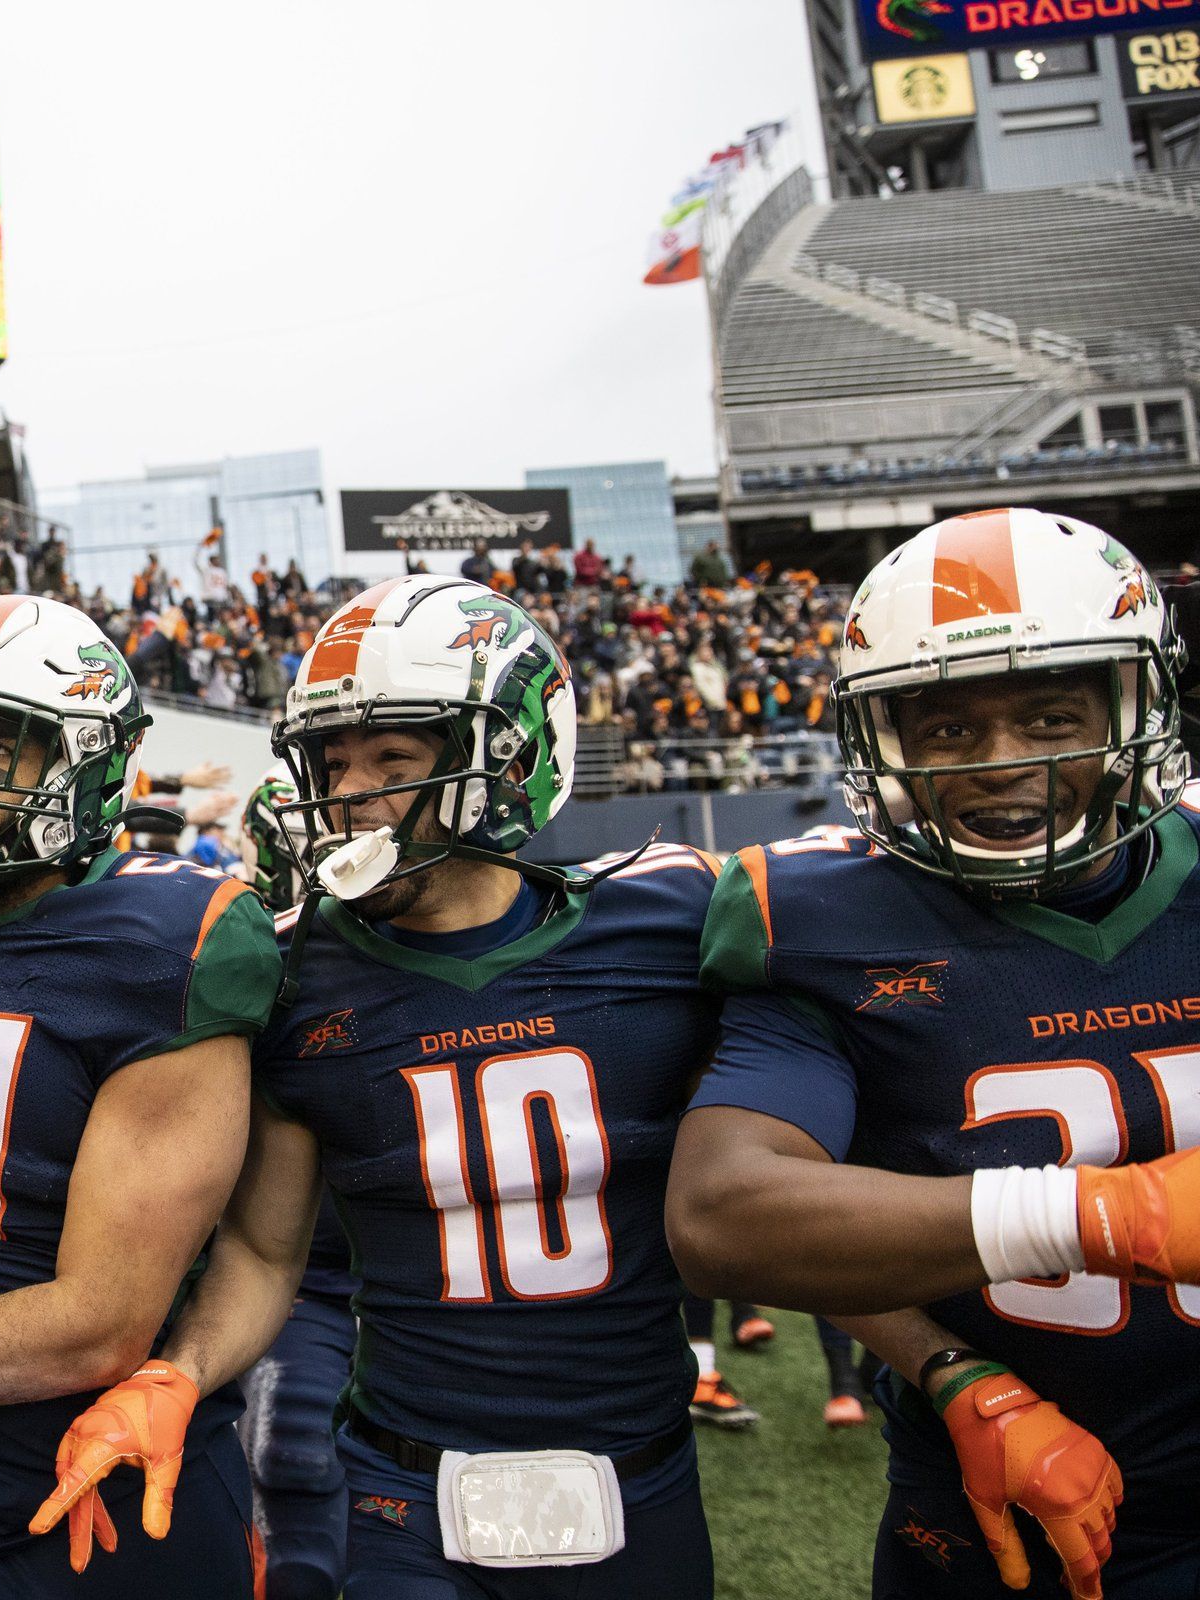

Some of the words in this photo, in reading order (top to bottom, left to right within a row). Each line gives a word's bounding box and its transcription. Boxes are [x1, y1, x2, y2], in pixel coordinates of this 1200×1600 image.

[1128, 30, 1199, 66] Q13
[1136, 62, 1200, 94] FOX
[947, 625, 1012, 643] DRAGONS
[420, 1015, 556, 1055] DRAGONS
[398, 1045, 614, 1303] 10
[984, 1388, 1022, 1407] CUTTERS
